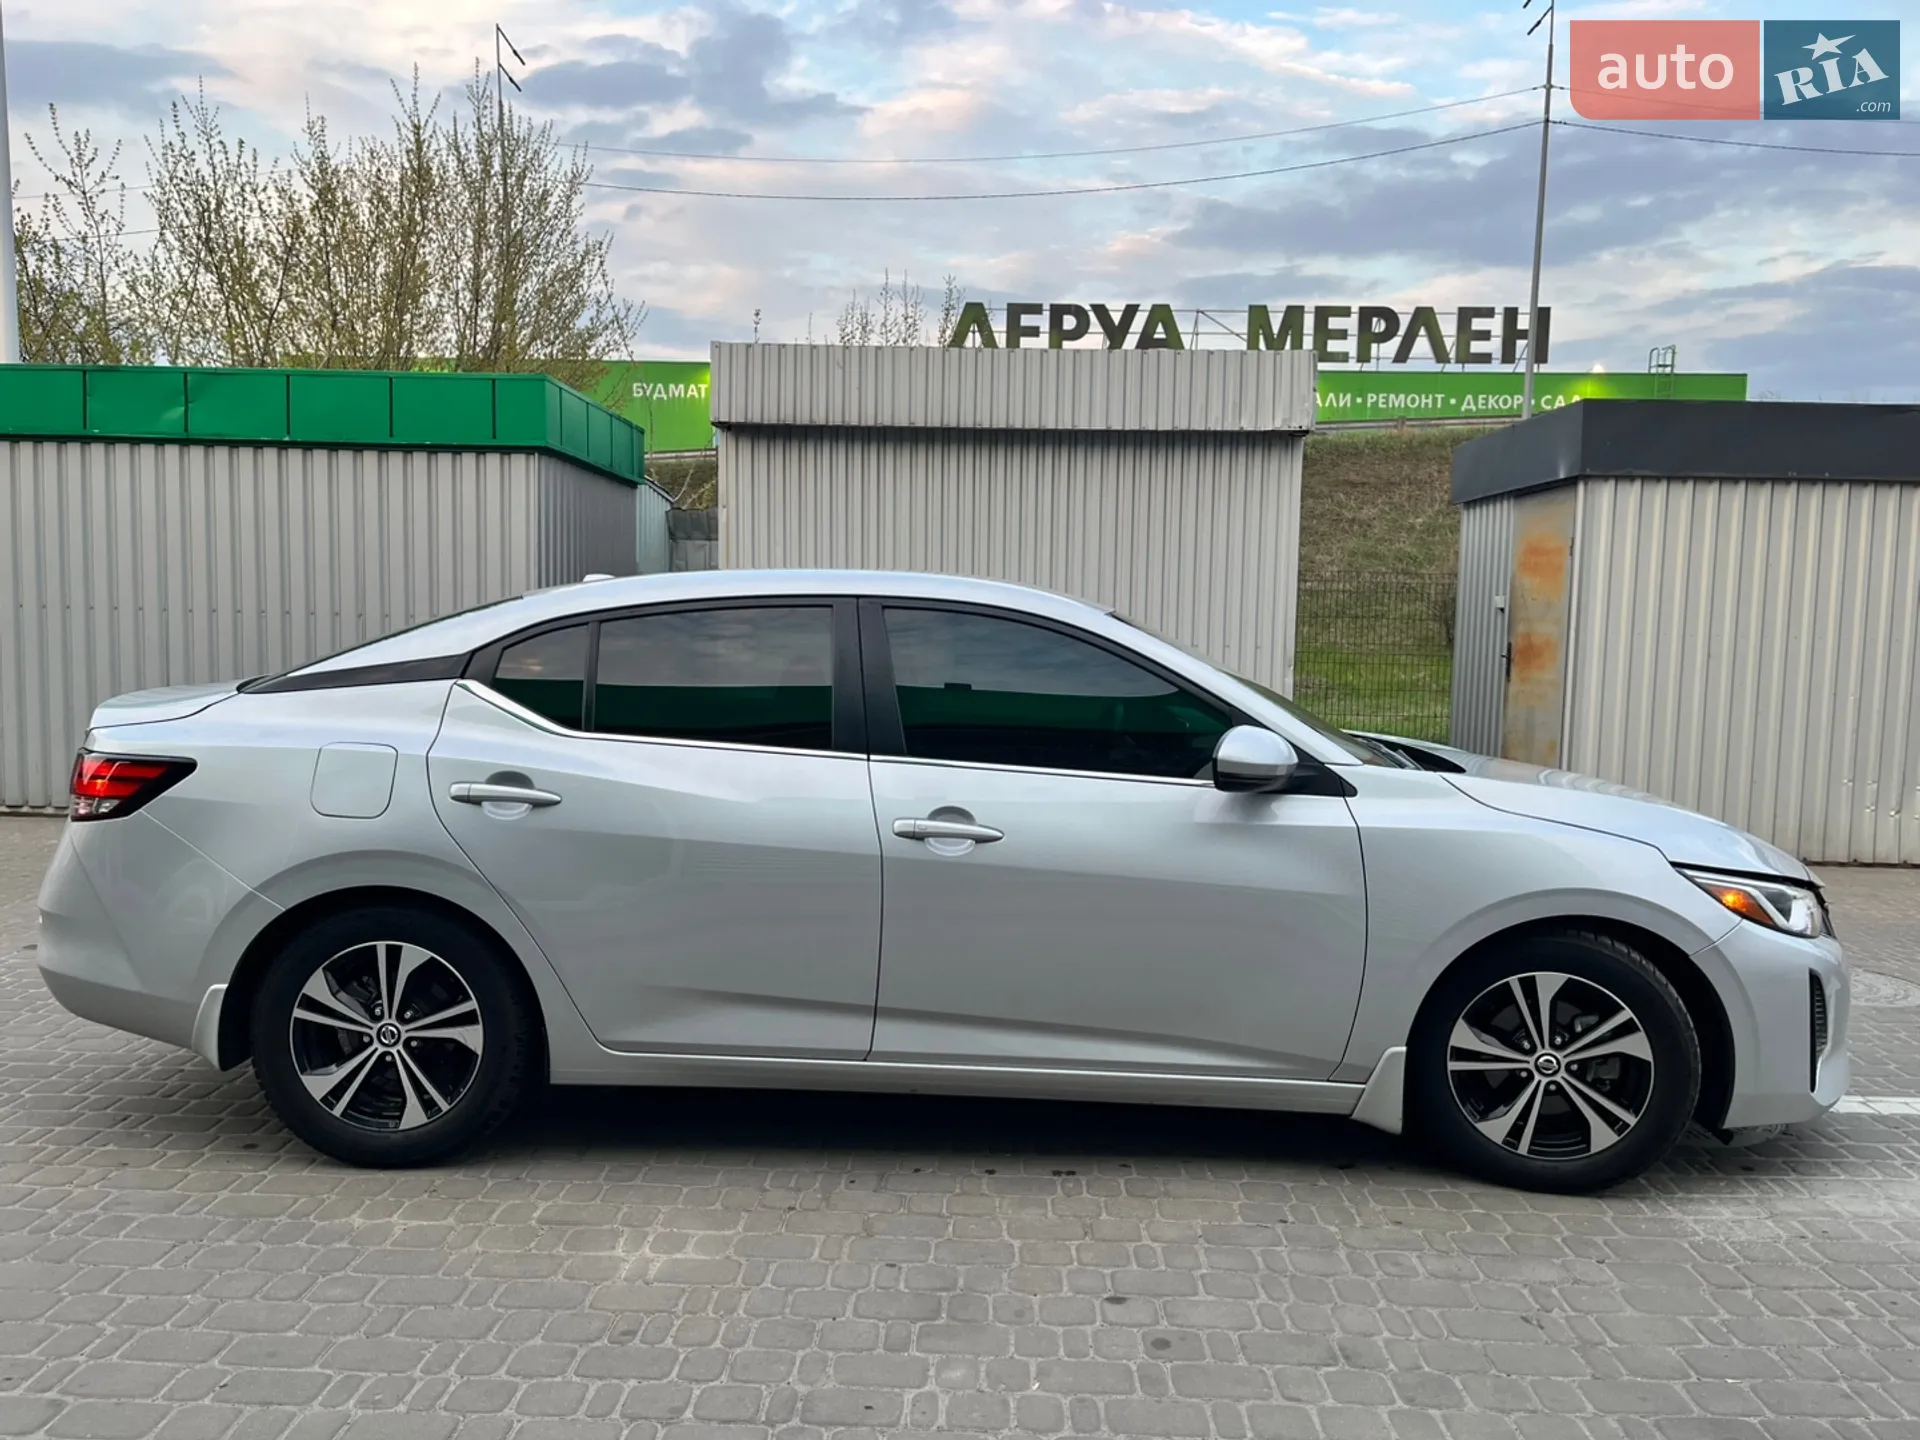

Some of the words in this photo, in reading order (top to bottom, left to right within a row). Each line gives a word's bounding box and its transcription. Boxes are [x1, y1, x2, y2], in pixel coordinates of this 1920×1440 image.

[1247, 304, 1551, 364] МЕРЛЕН
[1366, 393, 1445, 408] РЕМОНТ
[1461, 394, 1523, 412] ДЕКОР
